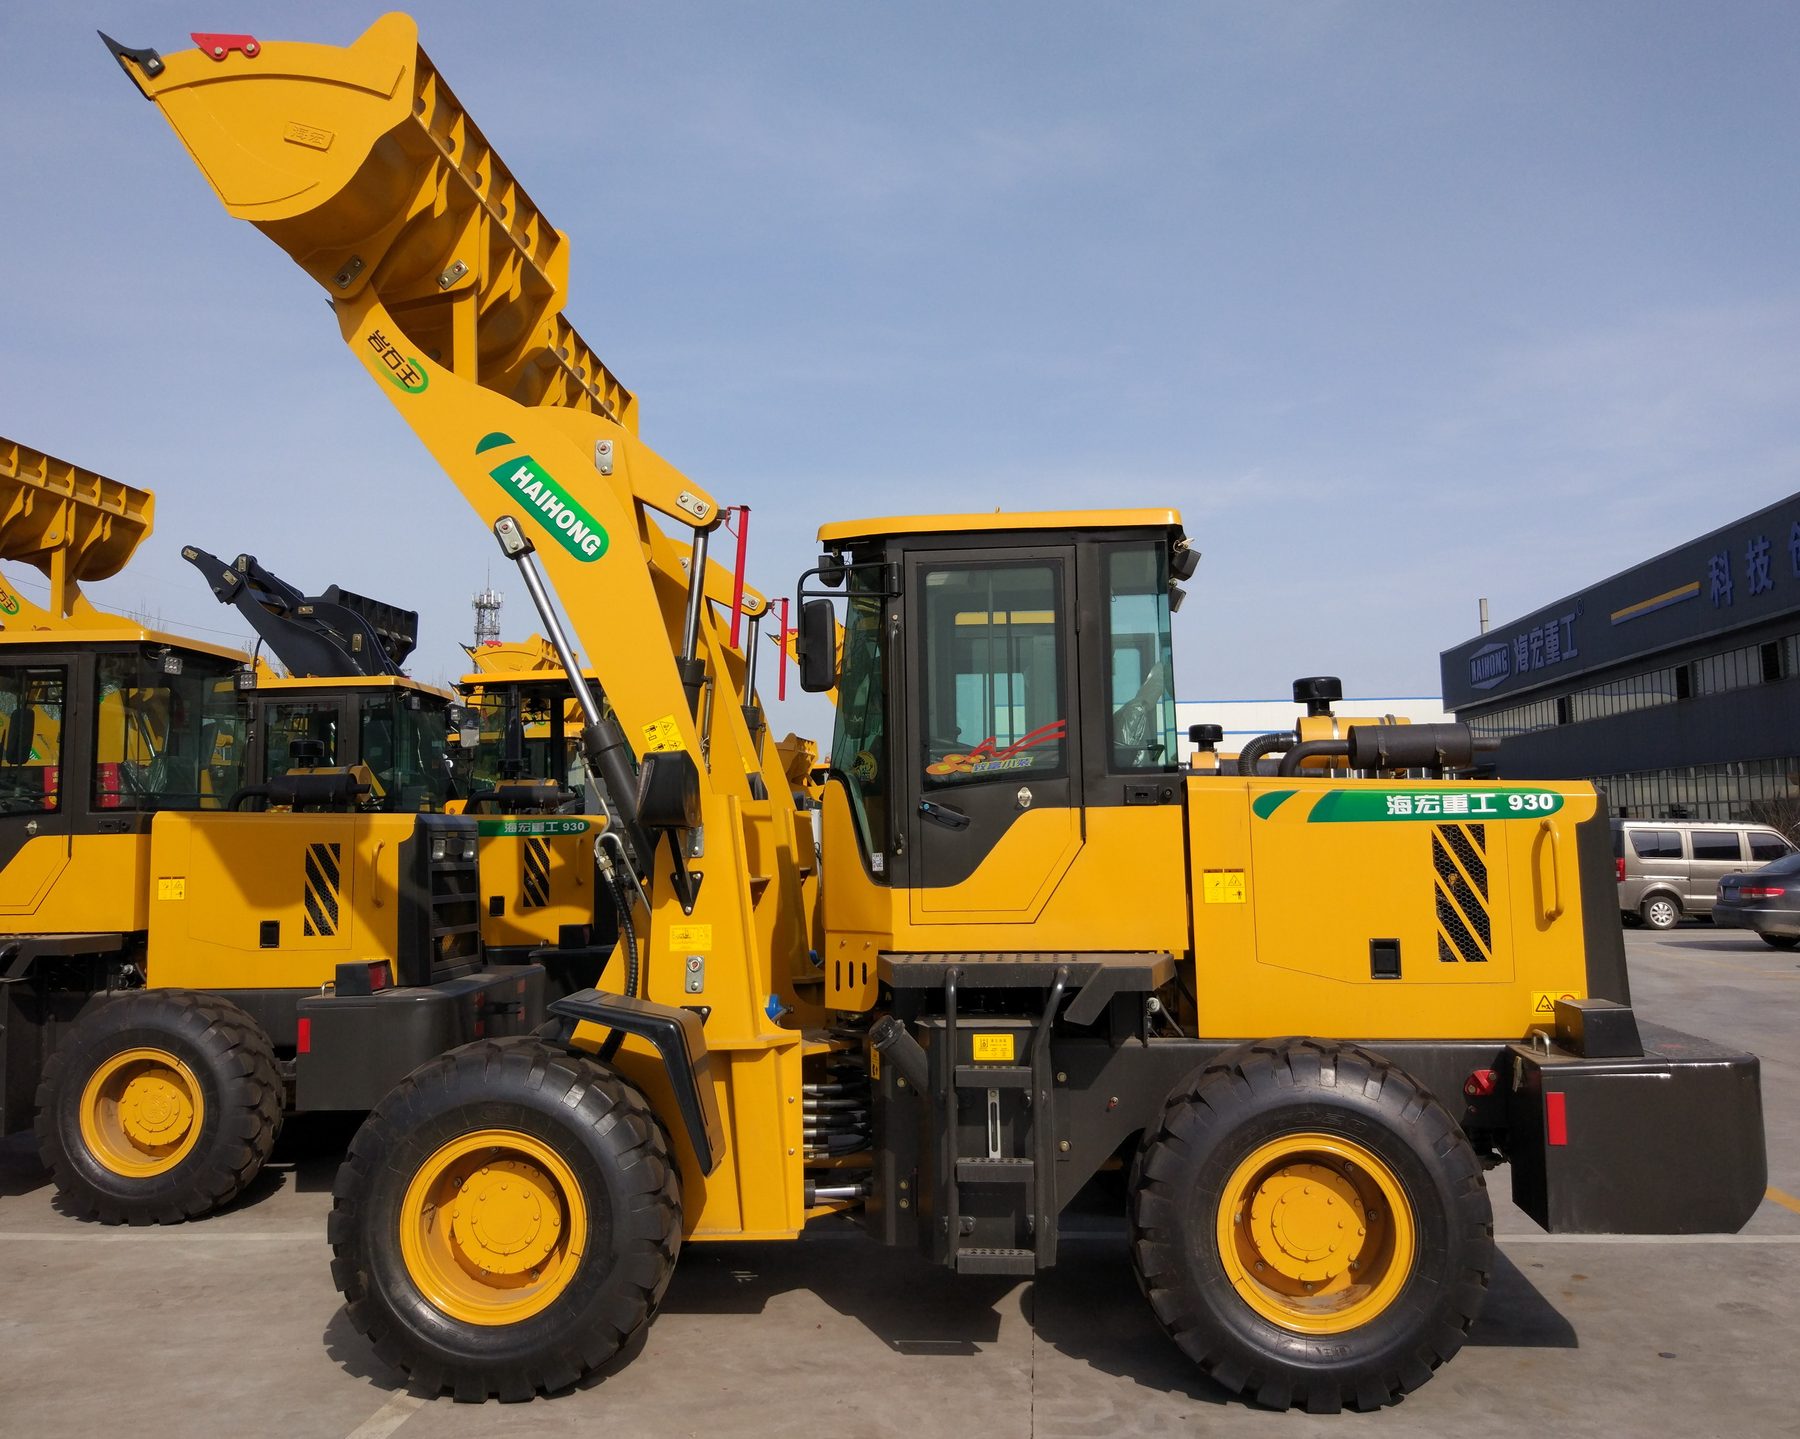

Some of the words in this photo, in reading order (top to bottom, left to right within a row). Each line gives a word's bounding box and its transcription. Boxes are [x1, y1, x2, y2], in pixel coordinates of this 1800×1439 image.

[367, 329, 420, 388] 岩石王
[510, 465, 601, 556] HAIHONG
[1513, 612, 1579, 675] 海宏重工
[504, 821, 558, 833] 海宏重工
[562, 821, 585, 831] 930
[1386, 793, 1497, 815] 海宏重工
[1508, 793, 1553, 811] 930
